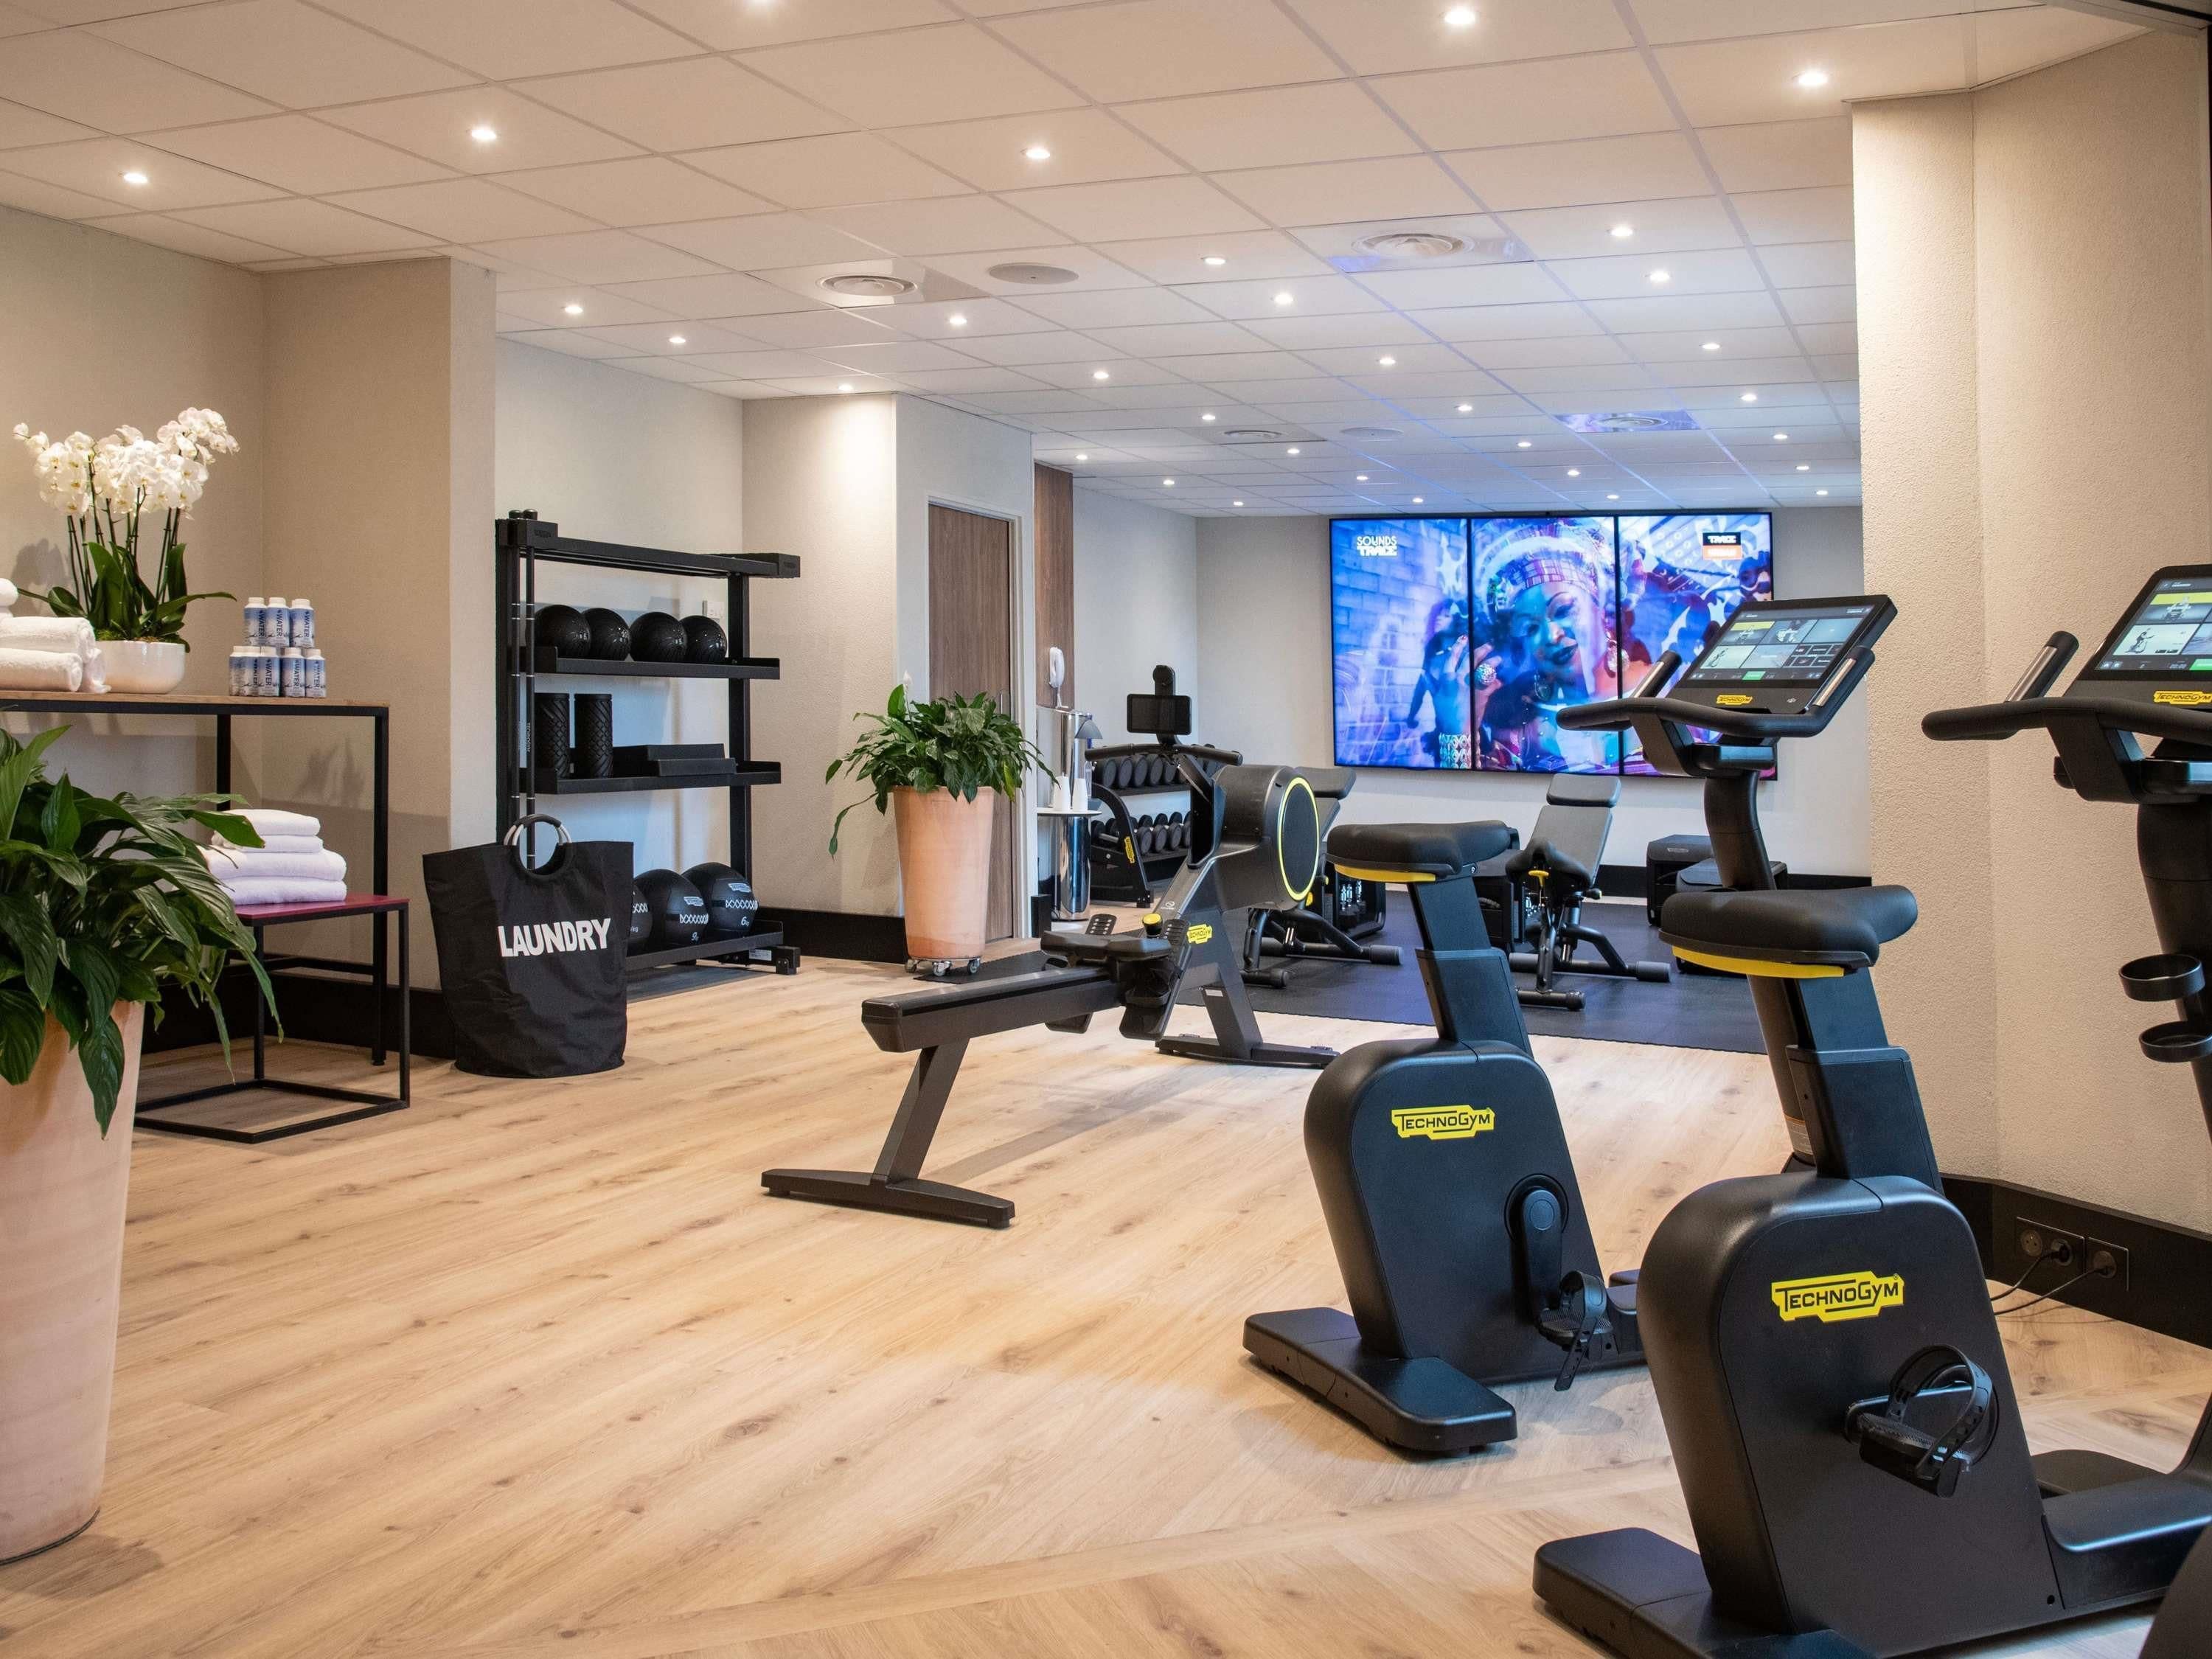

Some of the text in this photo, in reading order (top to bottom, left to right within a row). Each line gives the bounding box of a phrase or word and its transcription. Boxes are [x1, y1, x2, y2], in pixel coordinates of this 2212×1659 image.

[1356, 535, 1397, 546] SOUNDS
[258, 613, 266, 637] WATER
[498, 918, 611, 957] LAUNDRY
